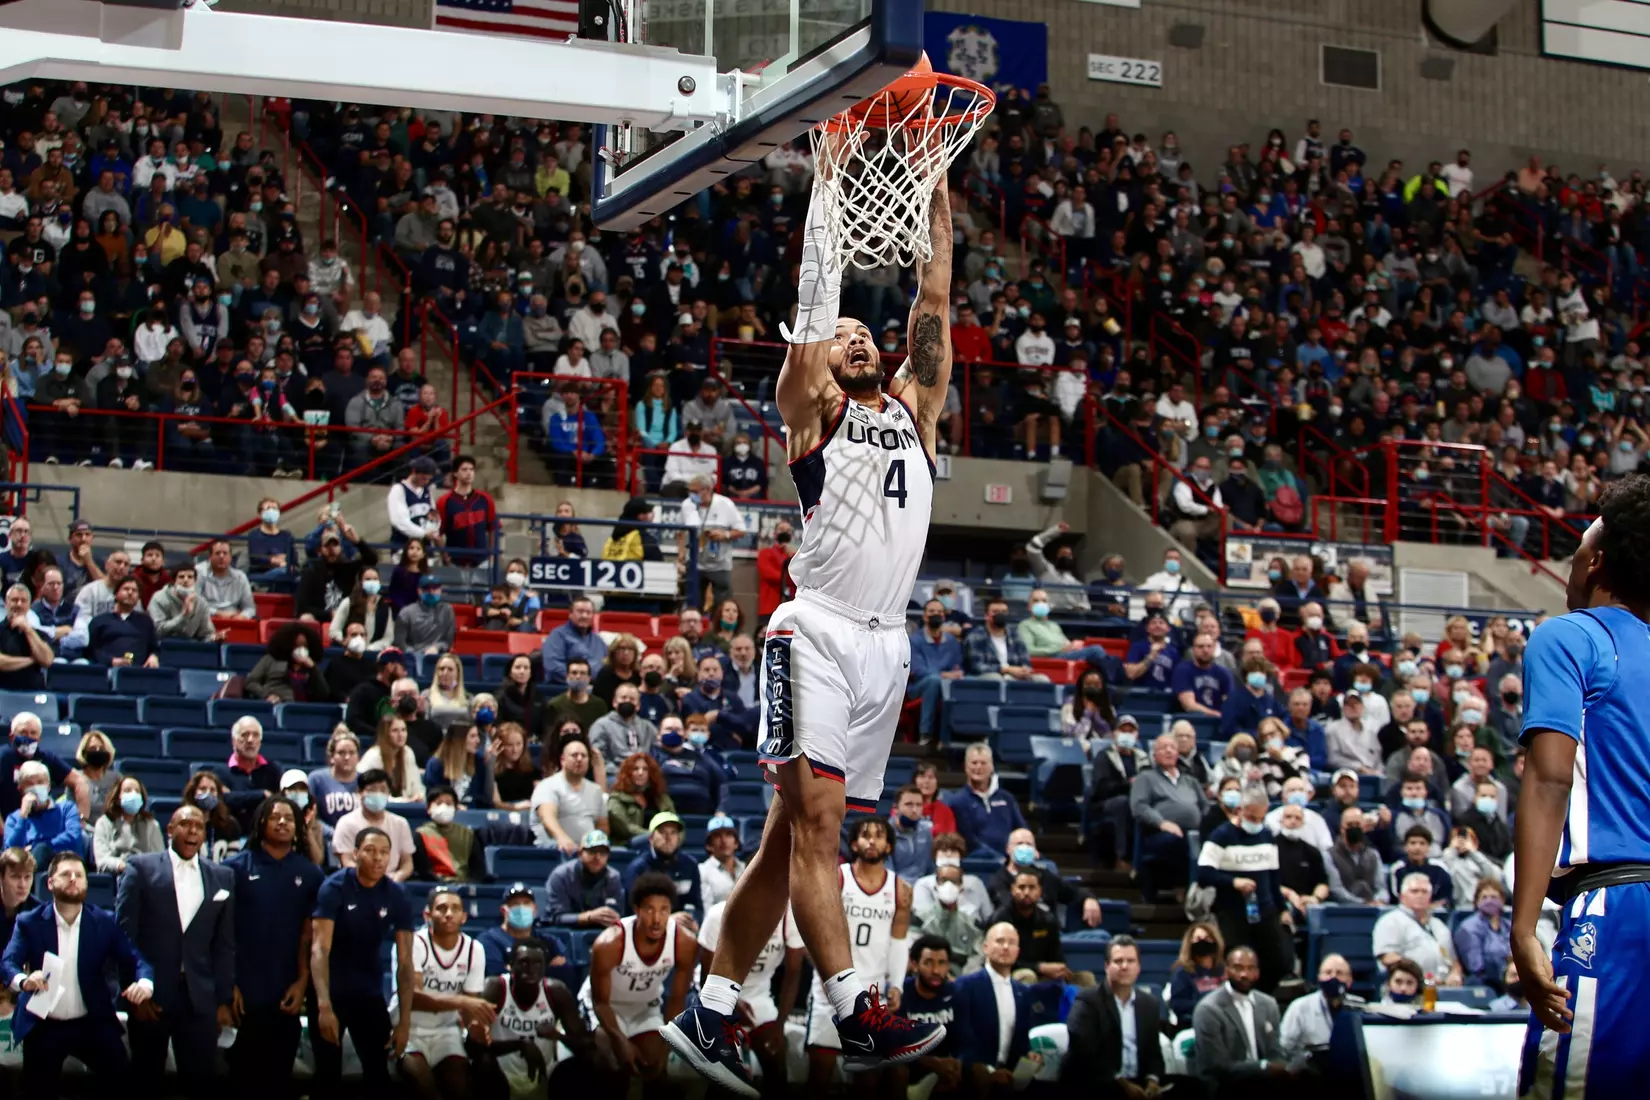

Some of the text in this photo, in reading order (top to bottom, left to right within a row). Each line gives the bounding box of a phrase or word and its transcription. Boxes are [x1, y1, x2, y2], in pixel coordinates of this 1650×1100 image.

[1091, 61, 1160, 82] SEC 222
[883, 459, 908, 509] 4
[532, 560, 643, 590] SEC 120
[766, 647, 784, 755] HUSKIES
[856, 922, 872, 947] 0
[629, 977, 653, 992] 13
